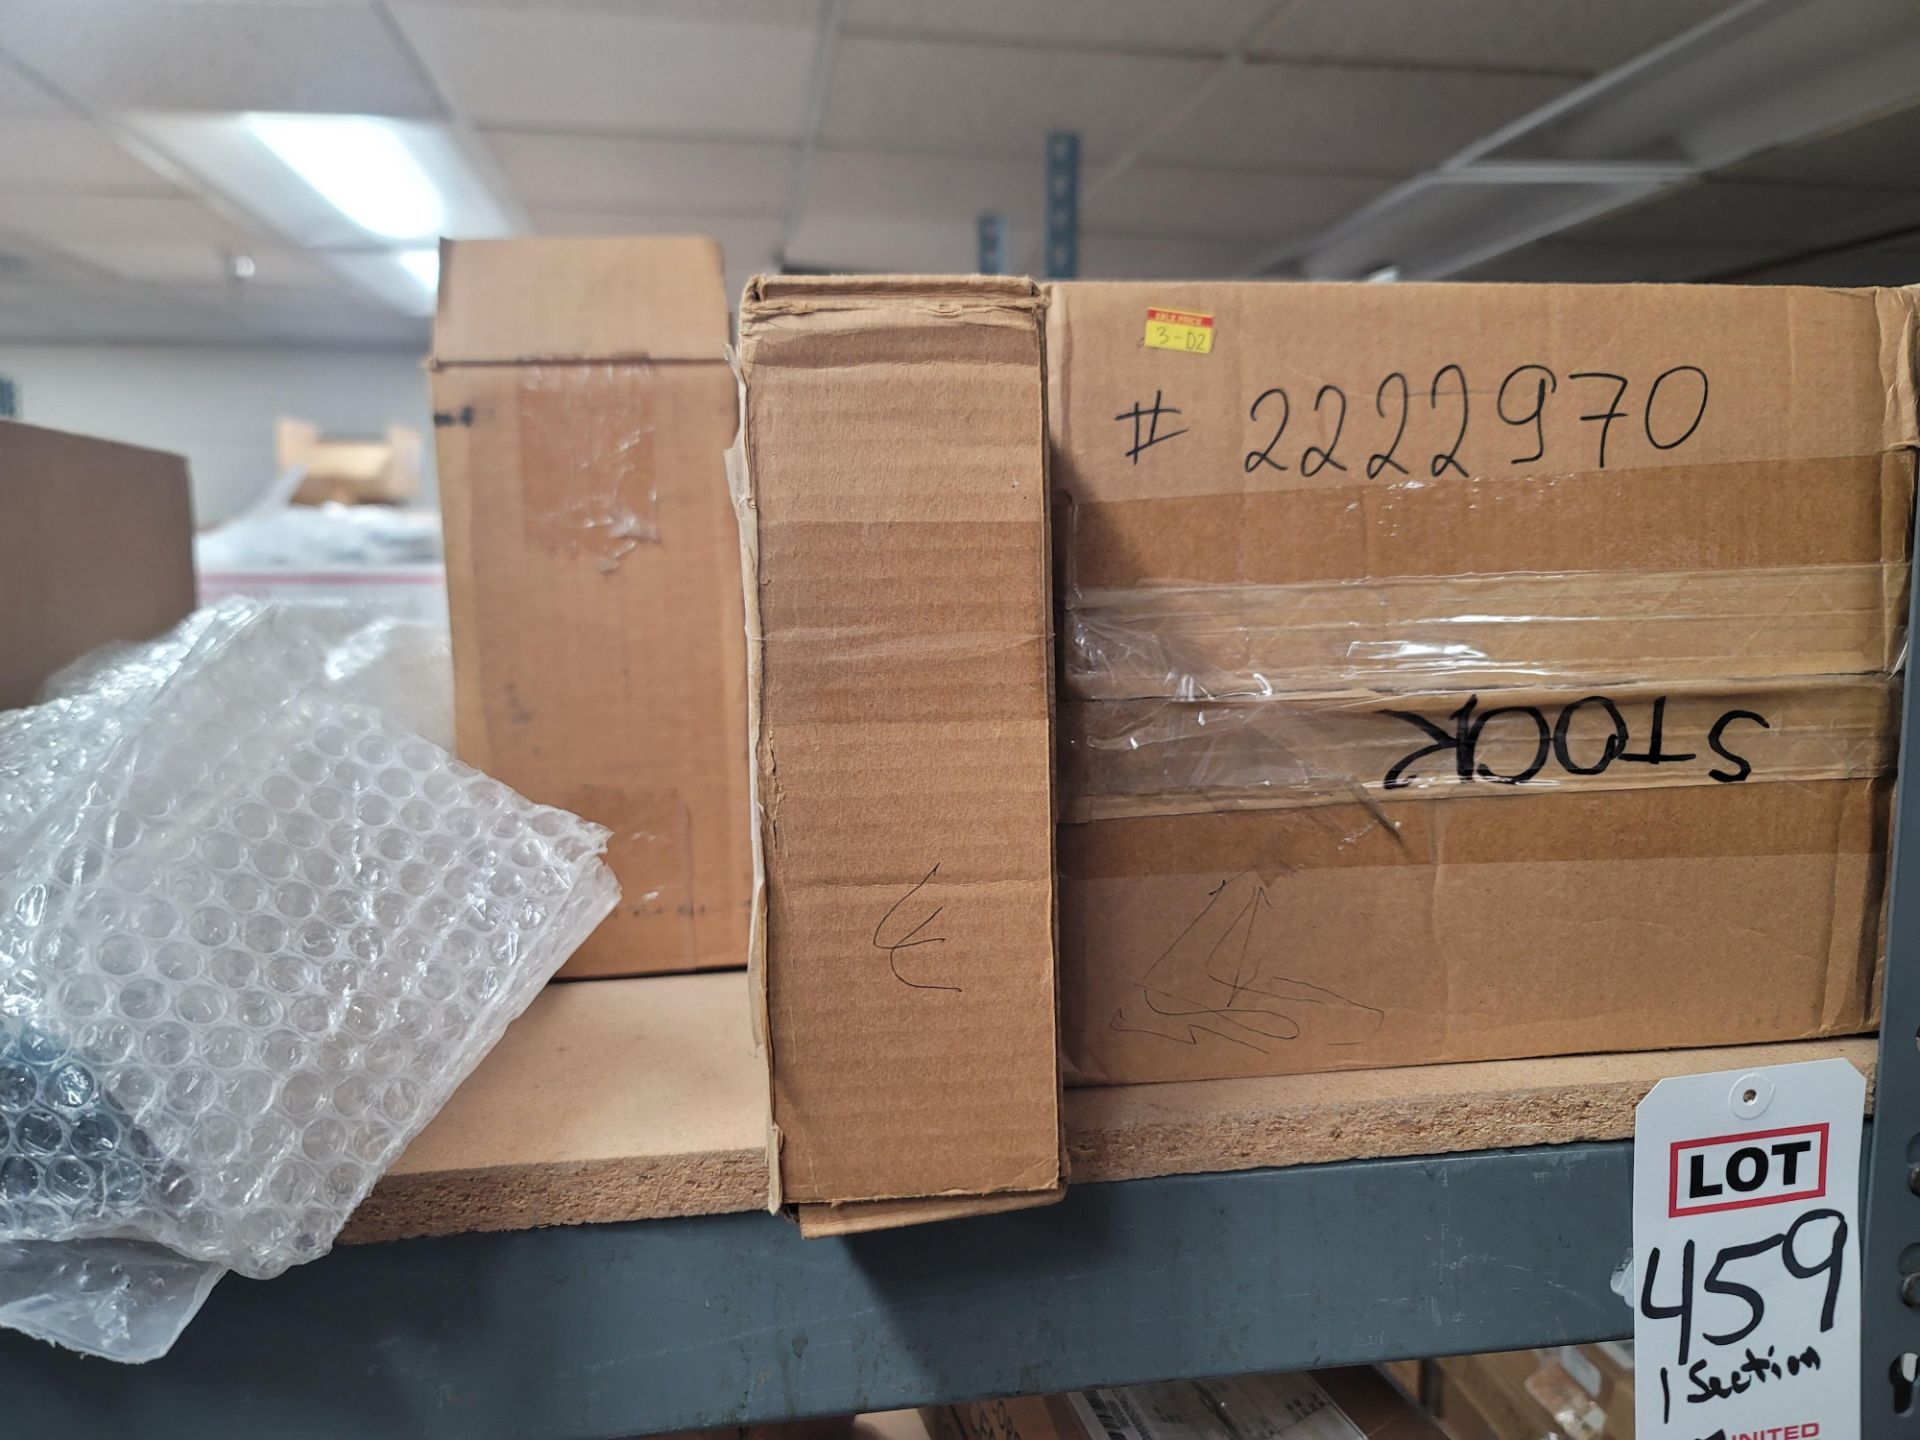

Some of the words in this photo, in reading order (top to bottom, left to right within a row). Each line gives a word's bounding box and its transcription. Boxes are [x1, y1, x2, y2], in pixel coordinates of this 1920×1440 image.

[1115, 390, 1188, 465] #
[1244, 364, 1709, 478] 2222970
[1373, 694, 1770, 790] STOCK
[1689, 1140, 1812, 1199] LOT
[1641, 1208, 1848, 1365] 459
[1687, 1345, 1821, 1403] Section
